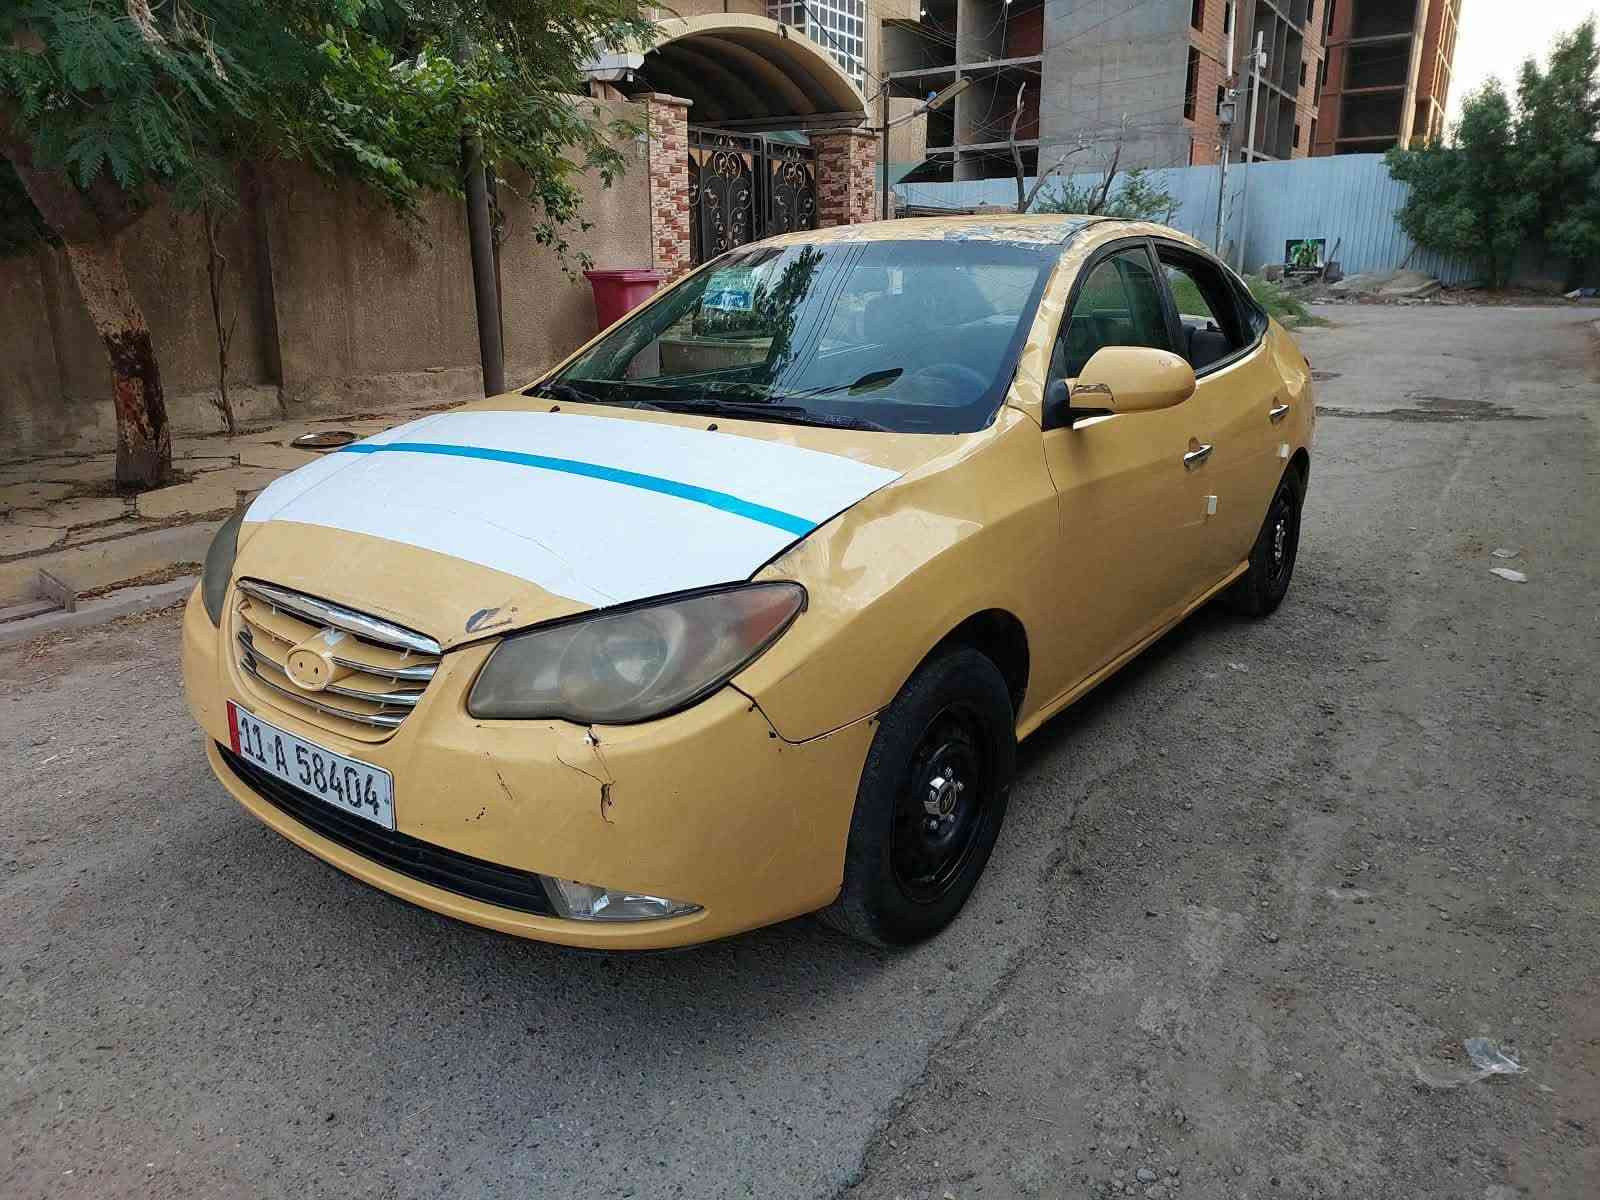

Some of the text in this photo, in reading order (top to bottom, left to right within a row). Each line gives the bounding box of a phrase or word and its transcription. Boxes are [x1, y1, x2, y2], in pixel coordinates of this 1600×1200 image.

[241, 717, 380, 815] 11 A 58404
